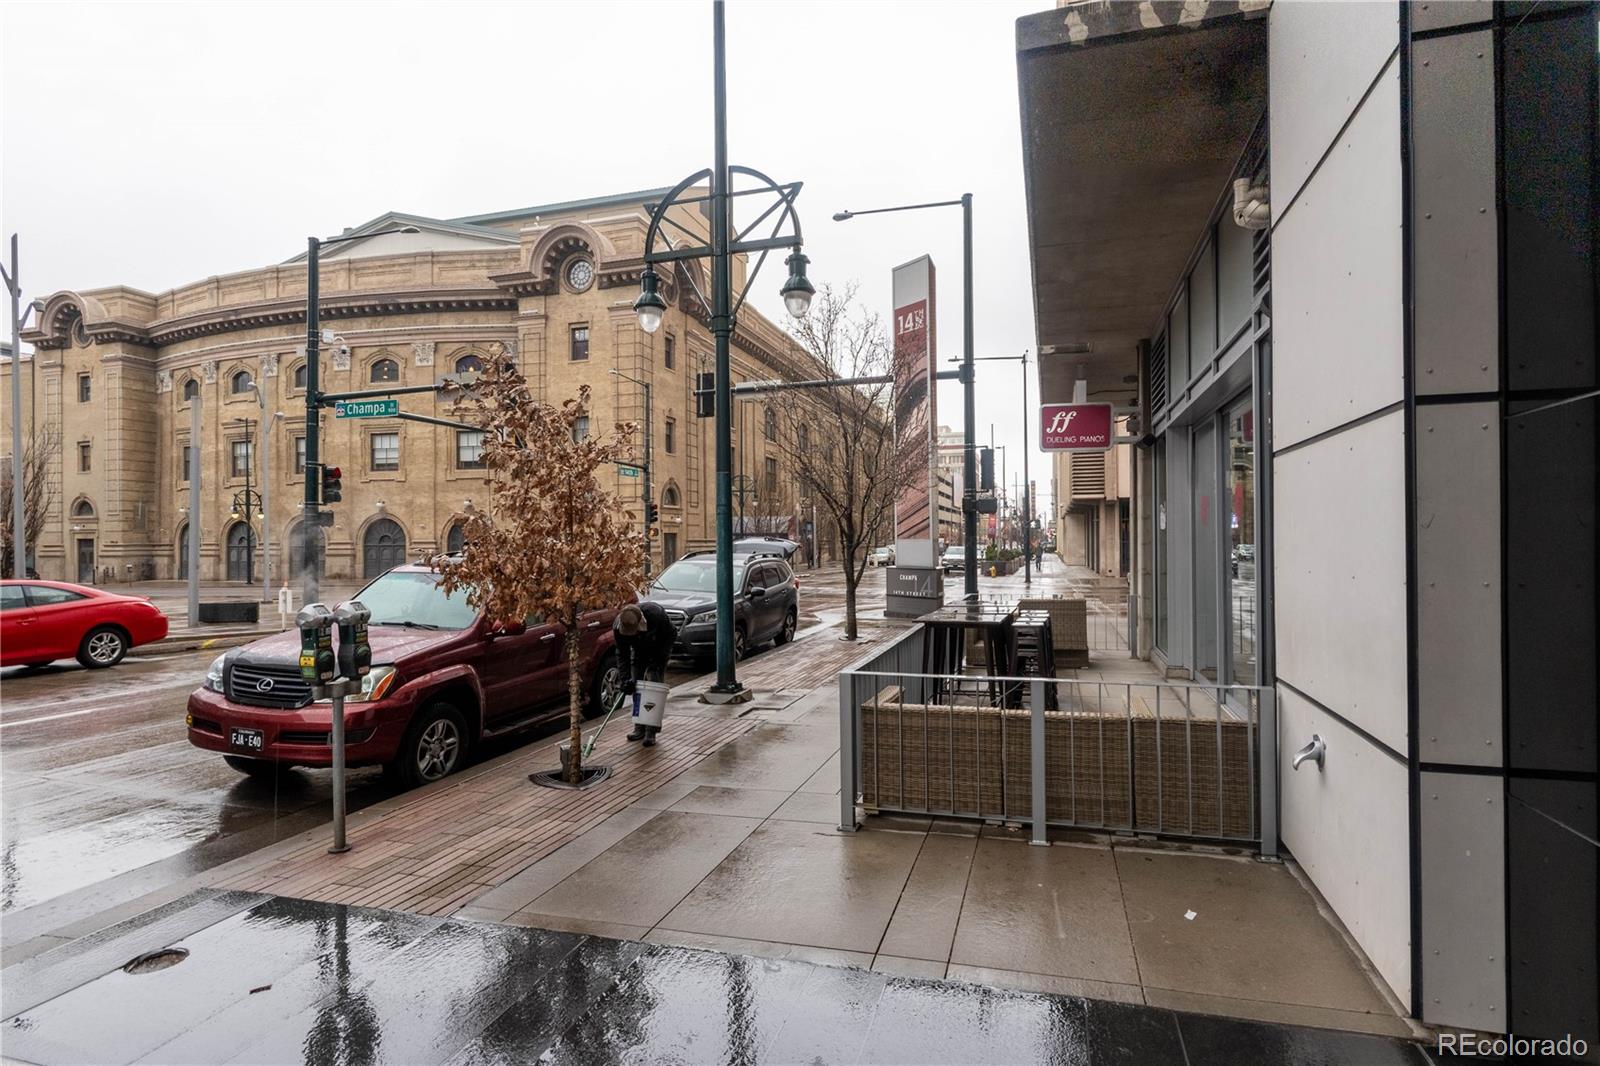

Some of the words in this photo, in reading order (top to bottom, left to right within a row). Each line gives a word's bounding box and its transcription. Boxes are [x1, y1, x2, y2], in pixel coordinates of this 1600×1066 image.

[347, 403, 385, 416] Champa
[1046, 409, 1077, 433] ff
[1080, 435, 1105, 443] PIANOS
